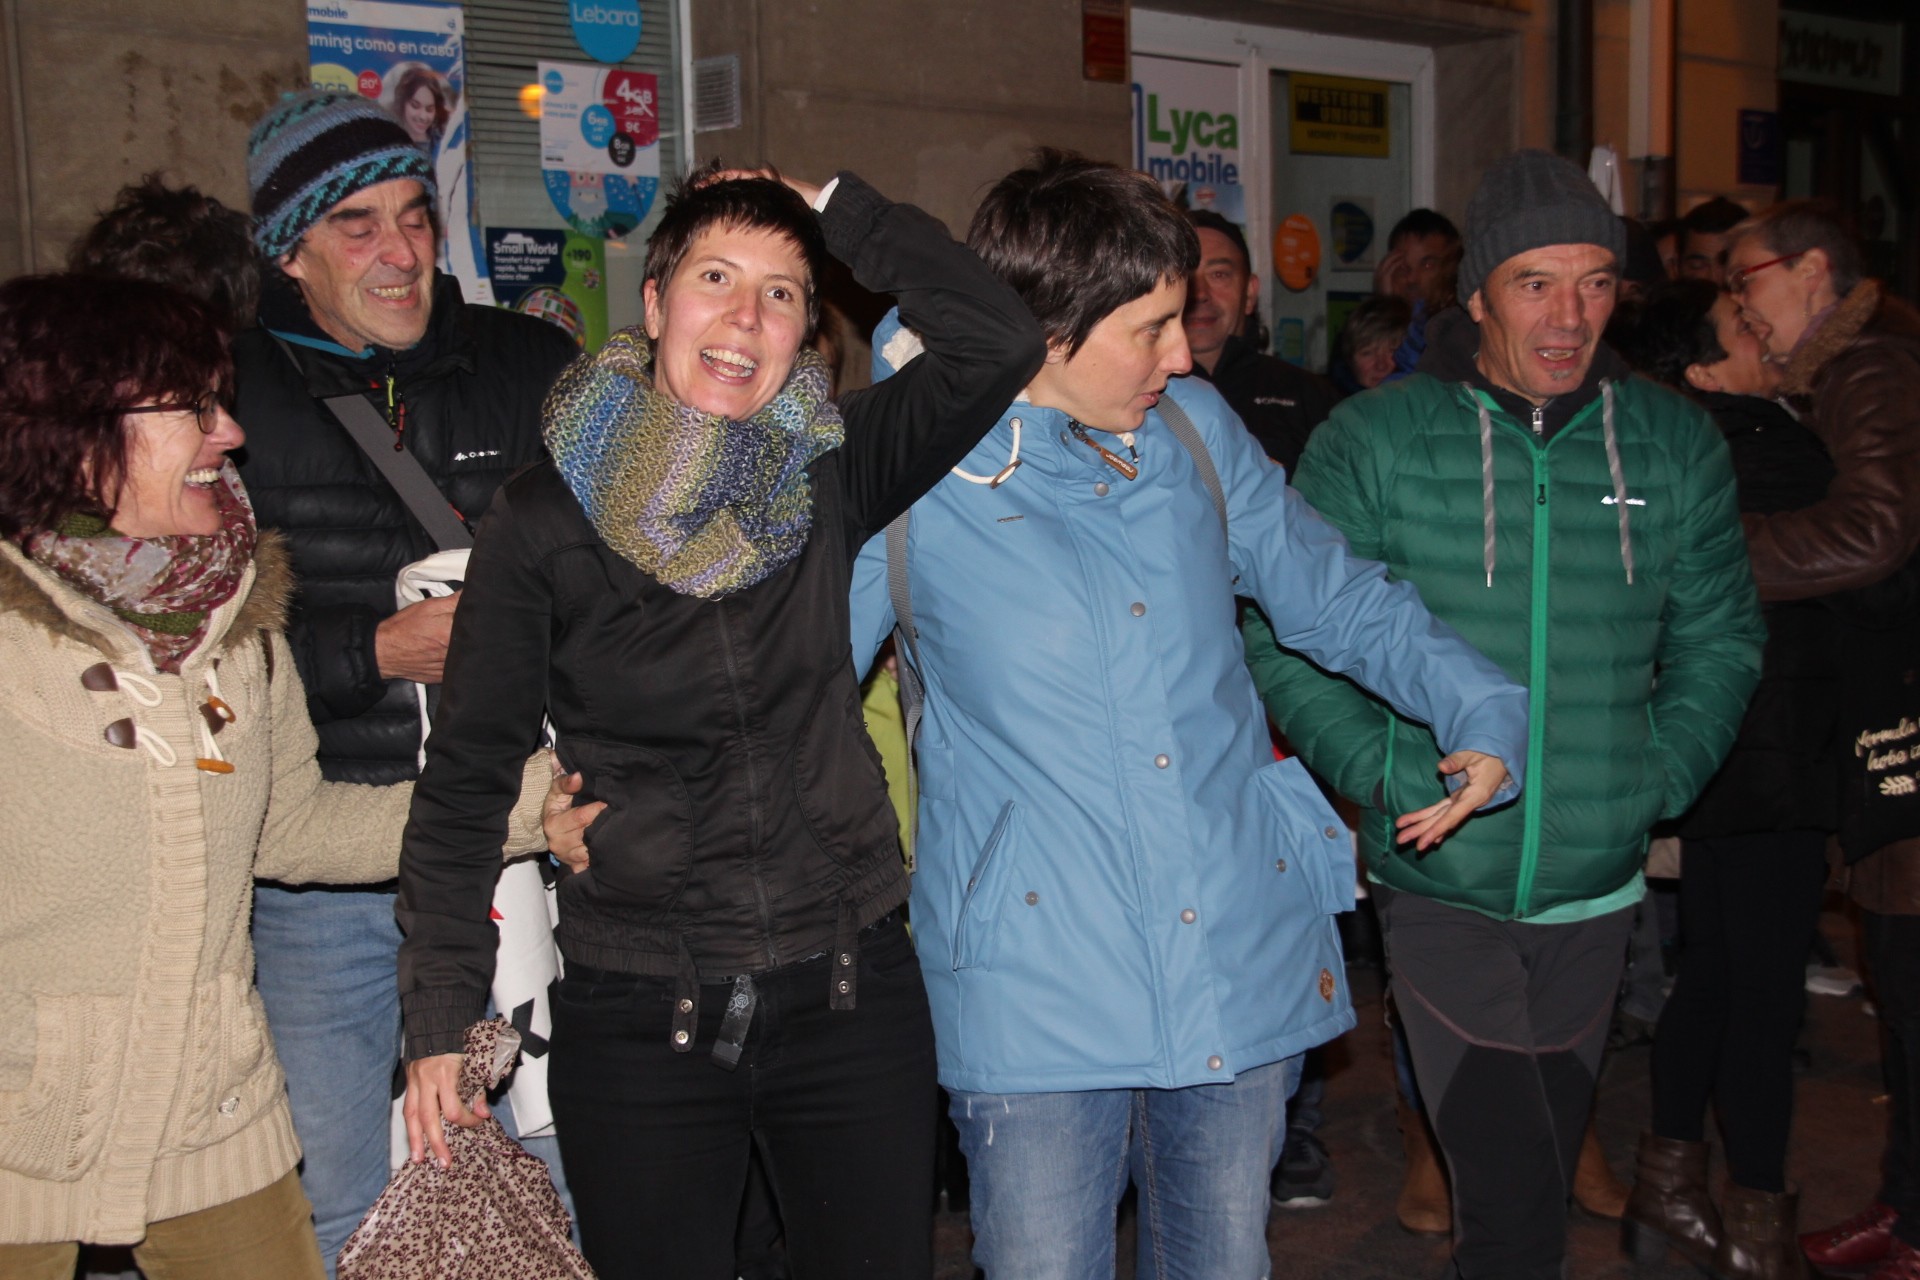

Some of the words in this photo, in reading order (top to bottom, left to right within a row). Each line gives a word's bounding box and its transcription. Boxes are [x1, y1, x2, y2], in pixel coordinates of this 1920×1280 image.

[308, 7, 348, 19] mobile
[573, 3, 638, 27] Lebara
[355, 37, 396, 53] como
[399, 44, 417, 55] en
[420, 46, 455, 57] casa
[1296, 87, 1370, 109] WESTERN
[1148, 93, 1238, 156] Lyca
[1321, 106, 1371, 126] UNION
[625, 121, 640, 133] 9€
[1149, 152, 1238, 185] mobile
[493, 242, 524, 254] Small
[526, 243, 558, 255] World
